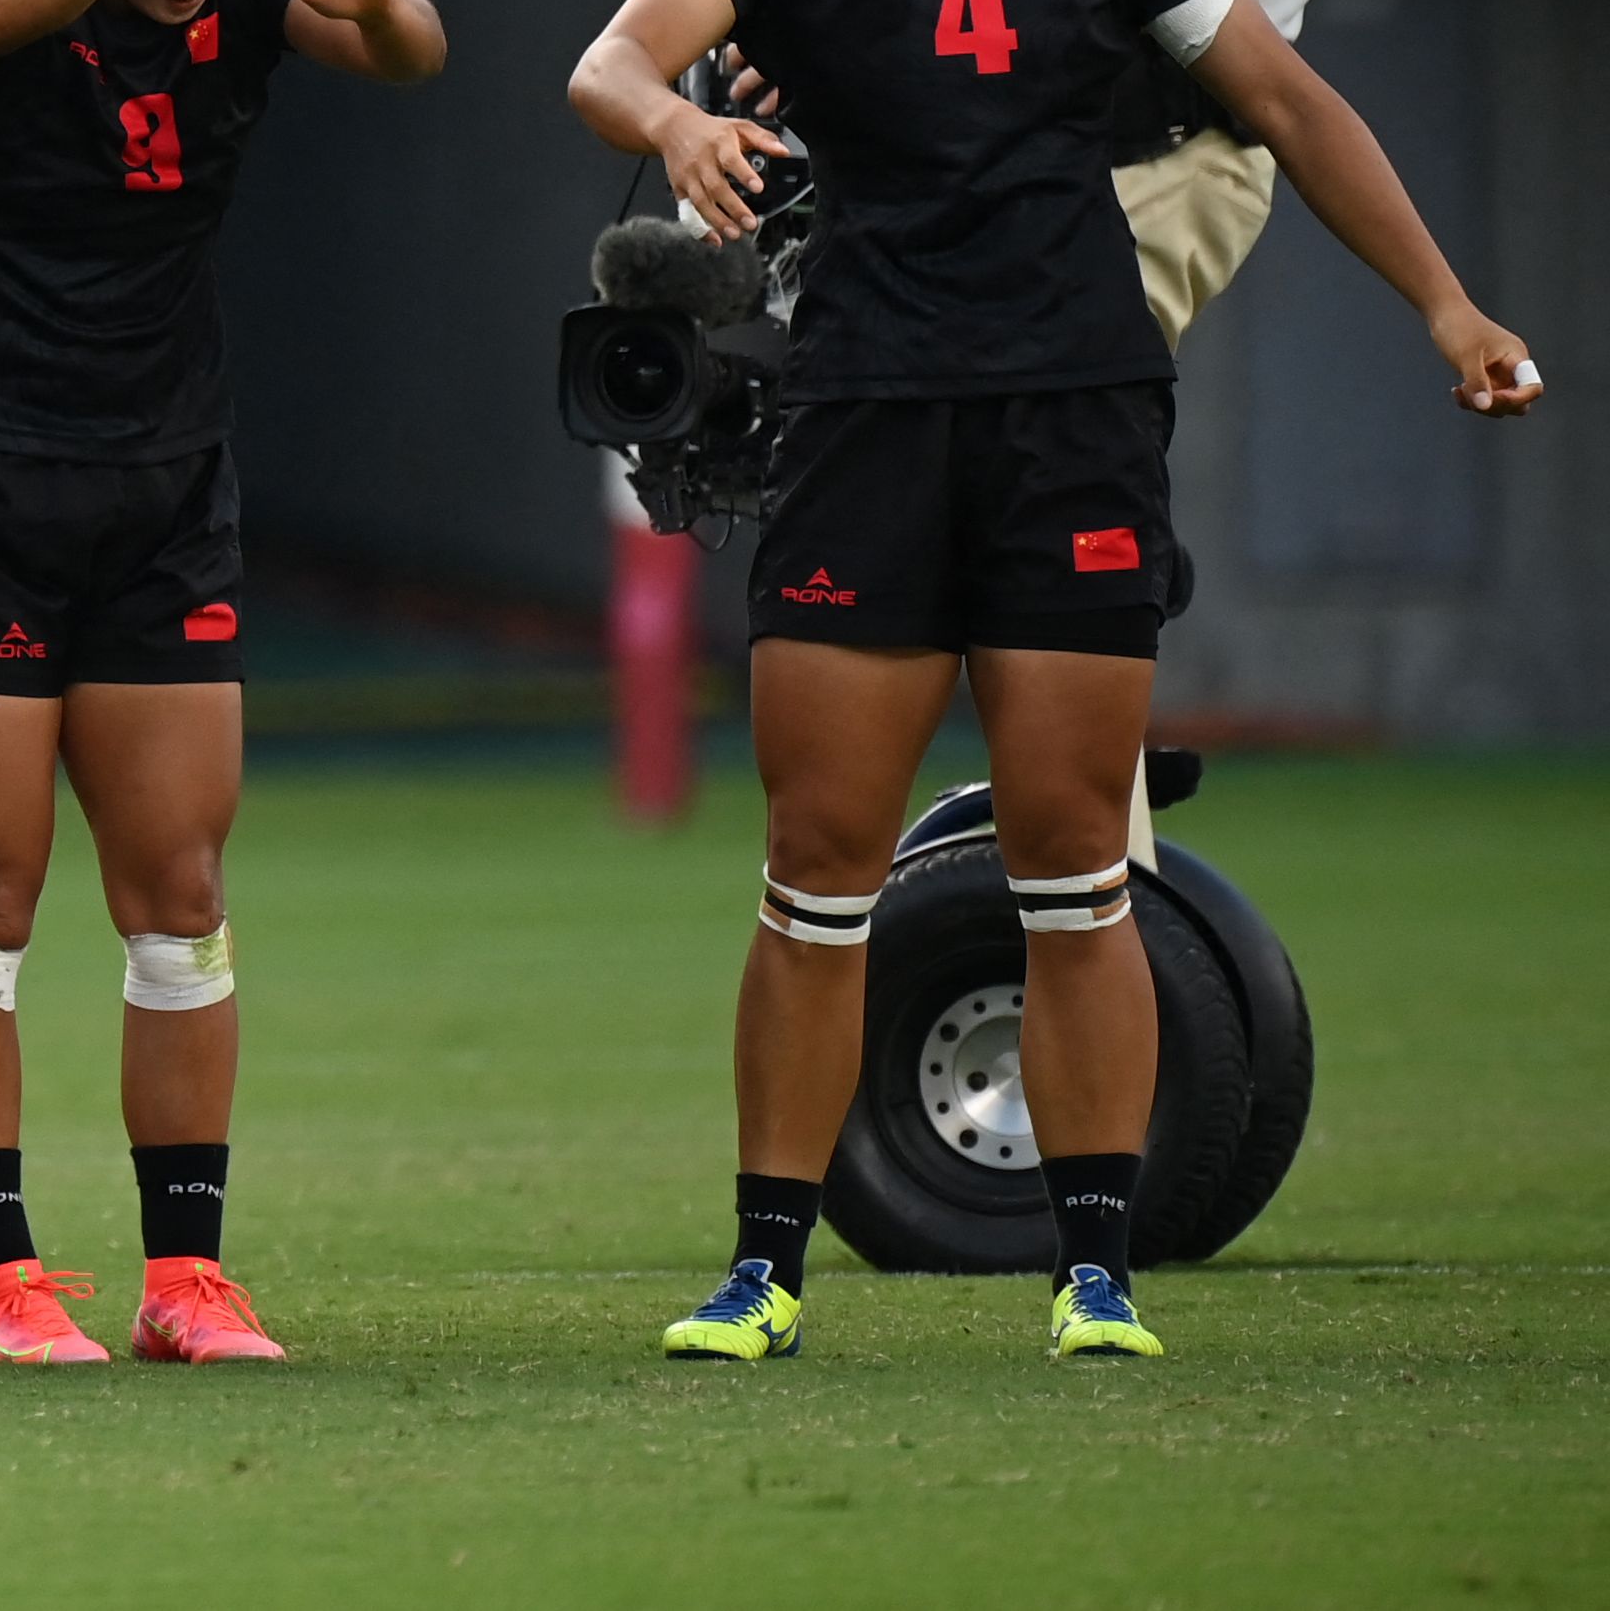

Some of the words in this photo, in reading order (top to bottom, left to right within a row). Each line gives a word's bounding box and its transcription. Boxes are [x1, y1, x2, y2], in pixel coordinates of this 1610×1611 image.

[780, 586, 859, 608] AONE
[168, 1182, 224, 1200] AON
[1065, 1193, 1127, 1212] AONE
